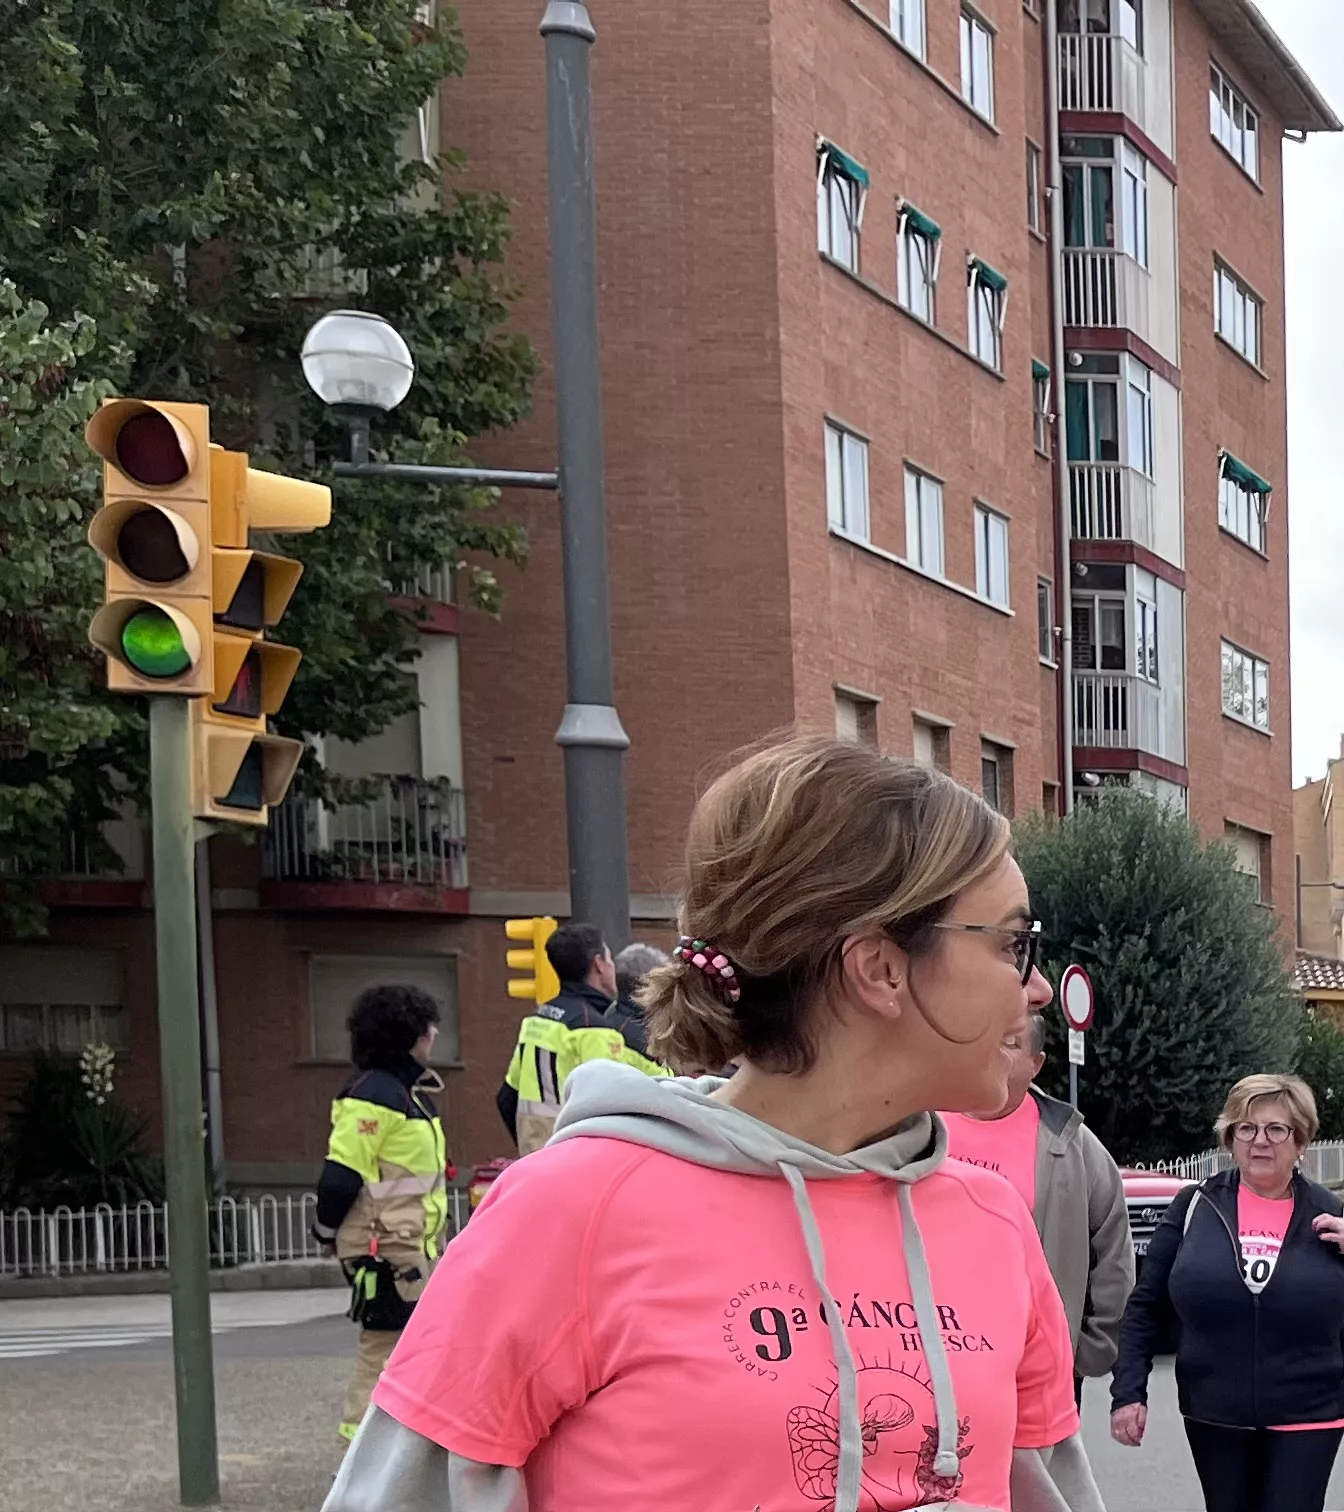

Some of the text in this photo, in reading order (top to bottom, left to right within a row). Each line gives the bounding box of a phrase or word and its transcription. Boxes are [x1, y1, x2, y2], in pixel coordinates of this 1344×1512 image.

[724, 1280, 805, 1318] CONTRA EL
[749, 1293, 962, 1362] 9ª CÁNCR
[722, 1322, 778, 1381] CARRERA
